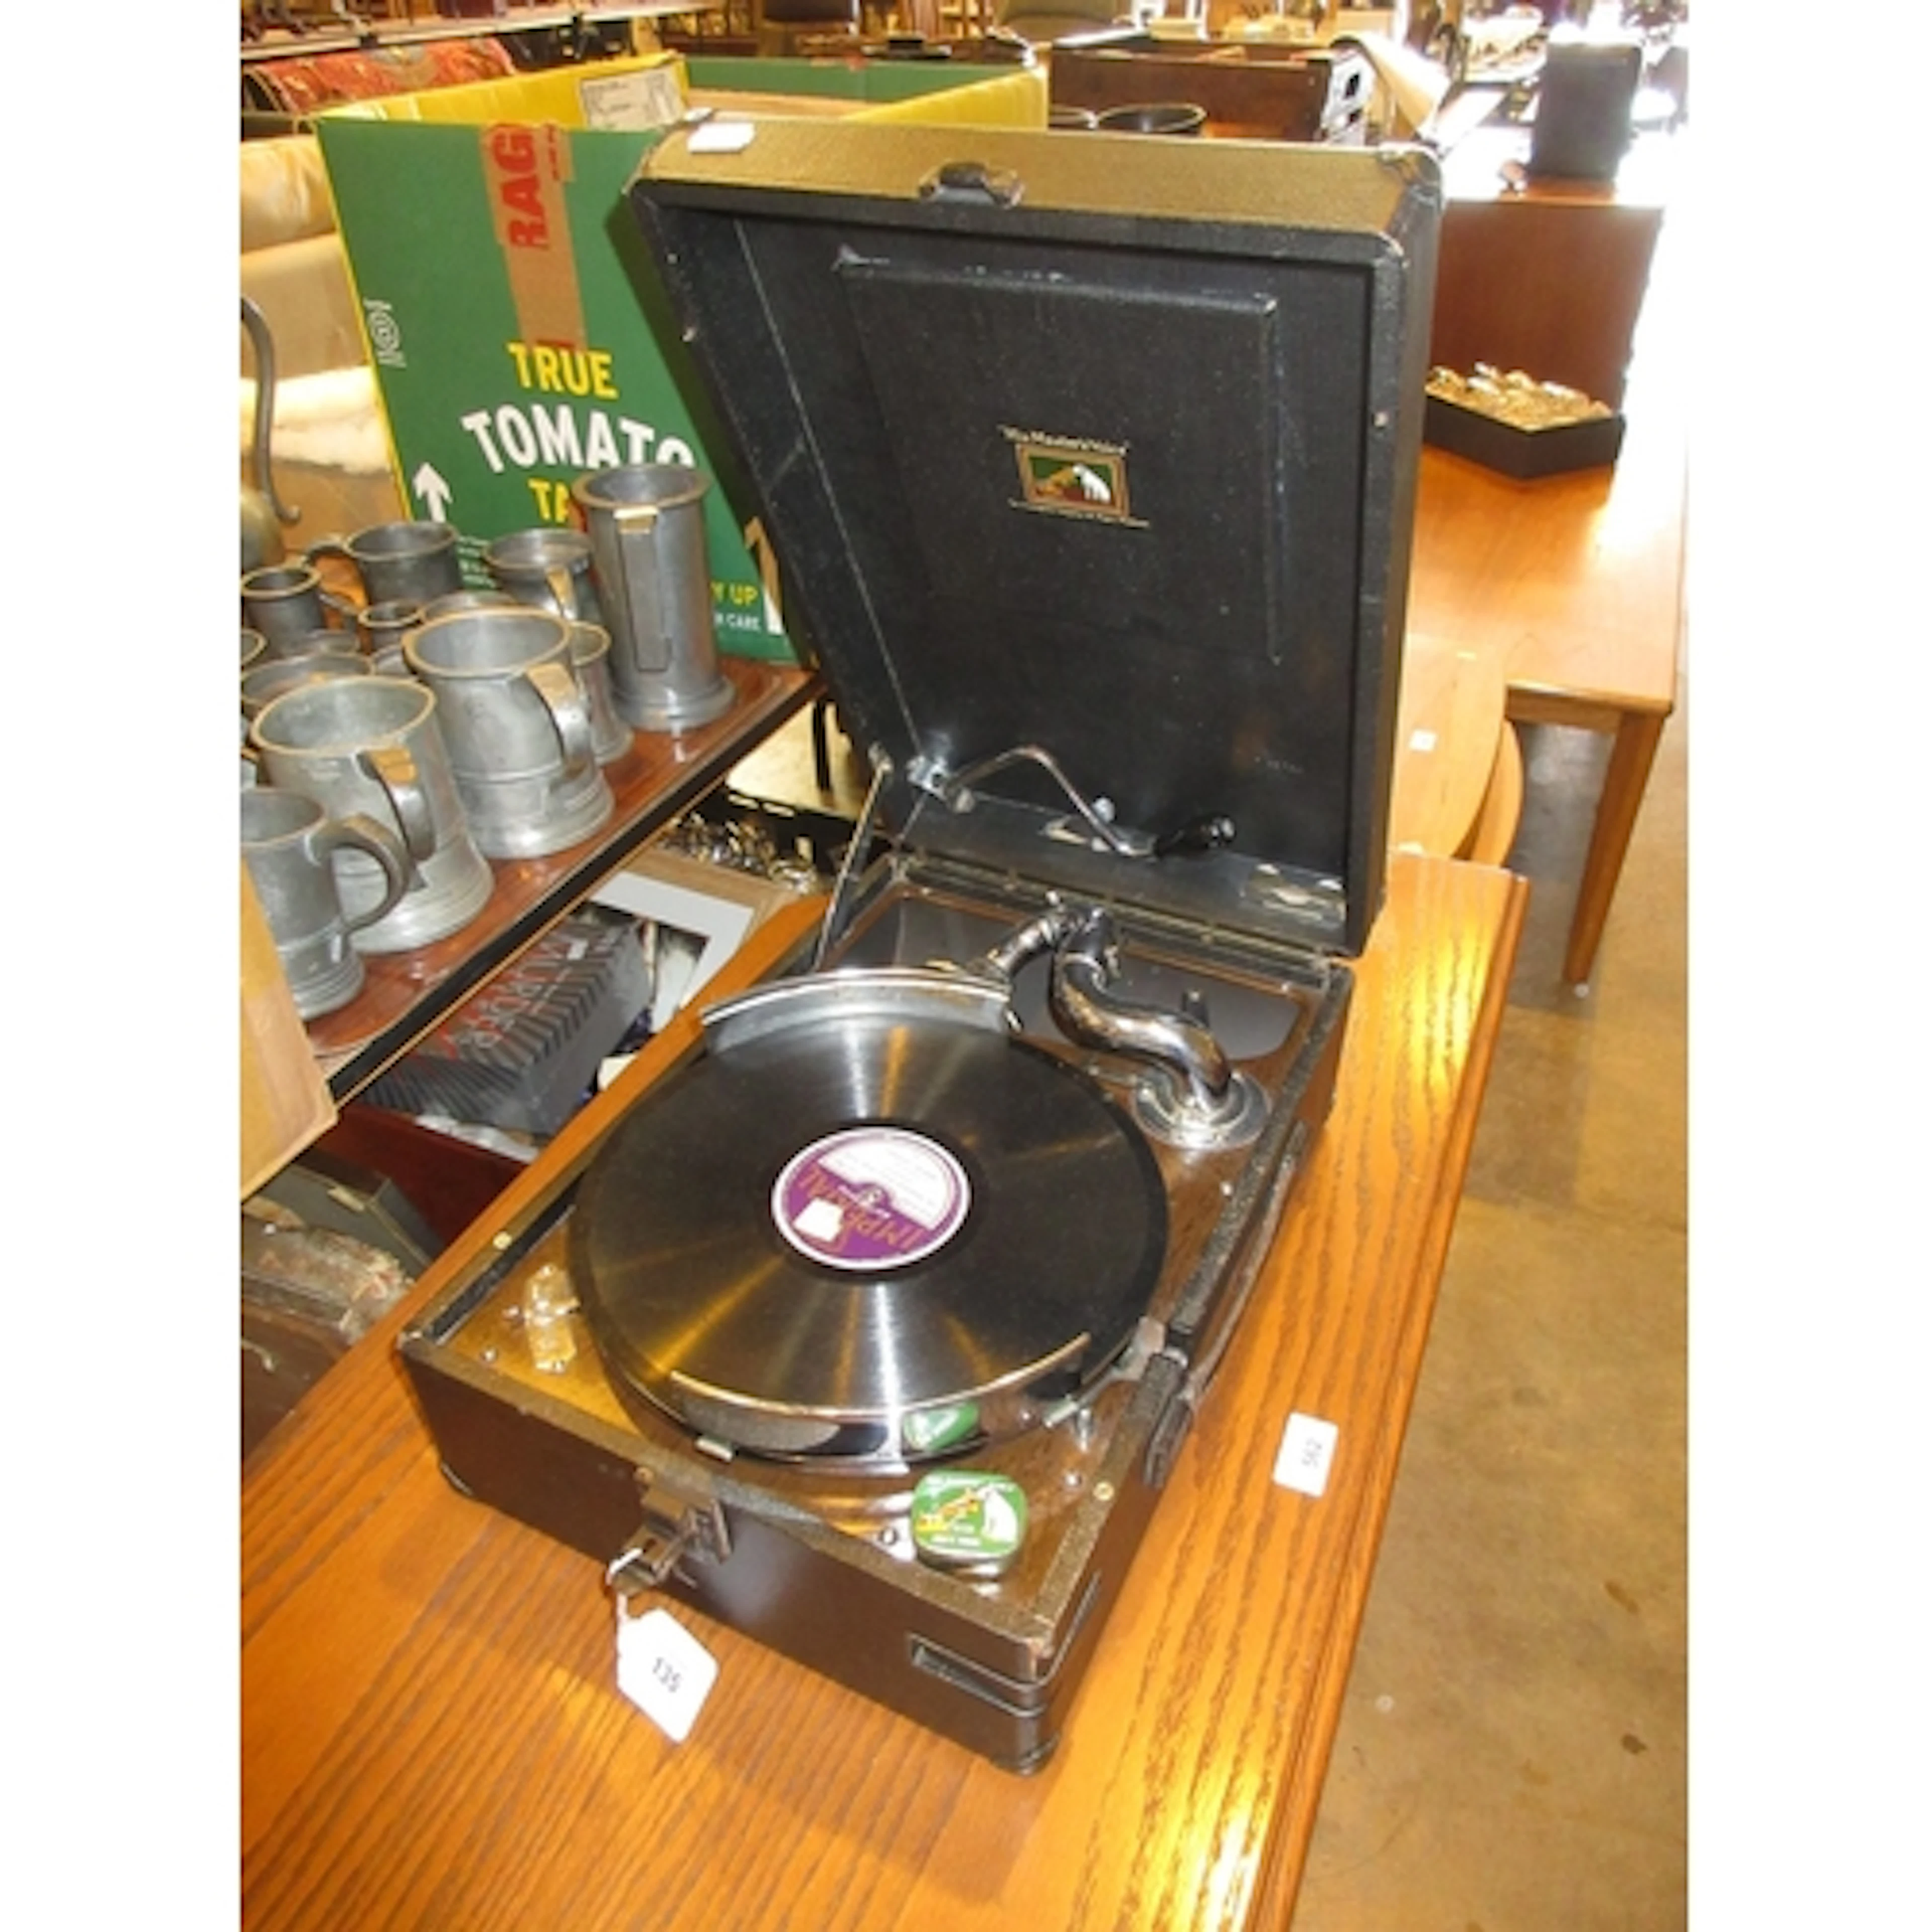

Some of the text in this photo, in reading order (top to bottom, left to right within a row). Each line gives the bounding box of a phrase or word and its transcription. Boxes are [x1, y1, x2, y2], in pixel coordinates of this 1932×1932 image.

[507, 342, 619, 399] TRUE
[729, 583, 759, 607] UP
[652, 1656, 682, 1693] 135
